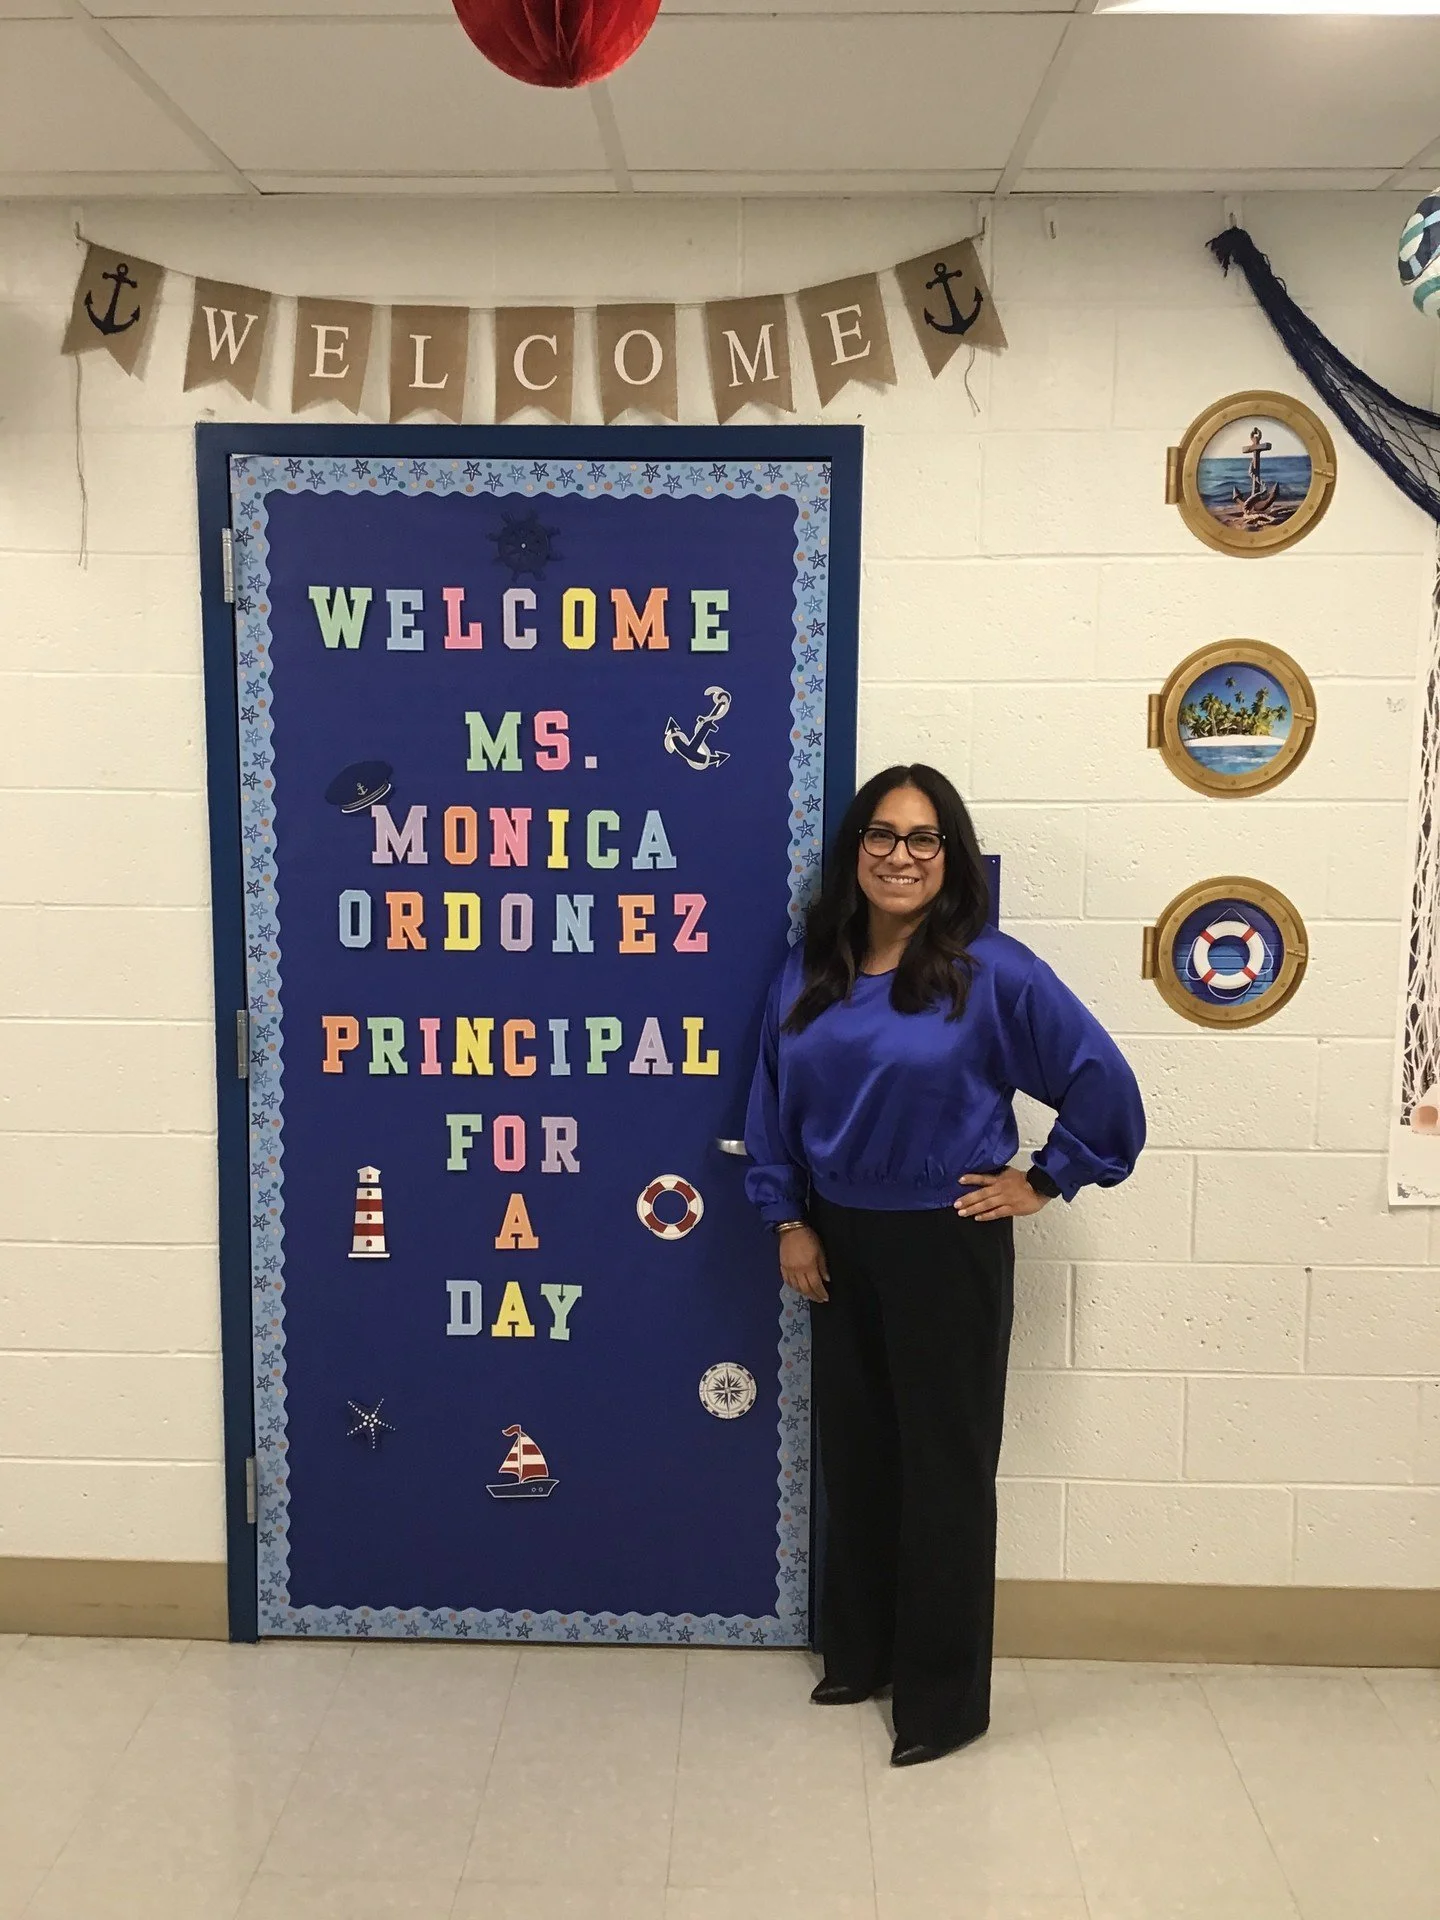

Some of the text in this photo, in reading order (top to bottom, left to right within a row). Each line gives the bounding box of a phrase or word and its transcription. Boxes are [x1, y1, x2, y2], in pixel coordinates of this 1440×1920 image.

[202, 303, 871, 391] WELCOME
[309, 586, 729, 651] WELCOME
[465, 711, 597, 771] MS.
[372, 805, 676, 869] MONICA
[339, 890, 708, 953] ORDONEZ
[322, 1016, 719, 1076] PRINCIPAL
[446, 1114, 579, 1172] FOR
[495, 1193, 539, 1249] A
[447, 1280, 582, 1340] DAY
